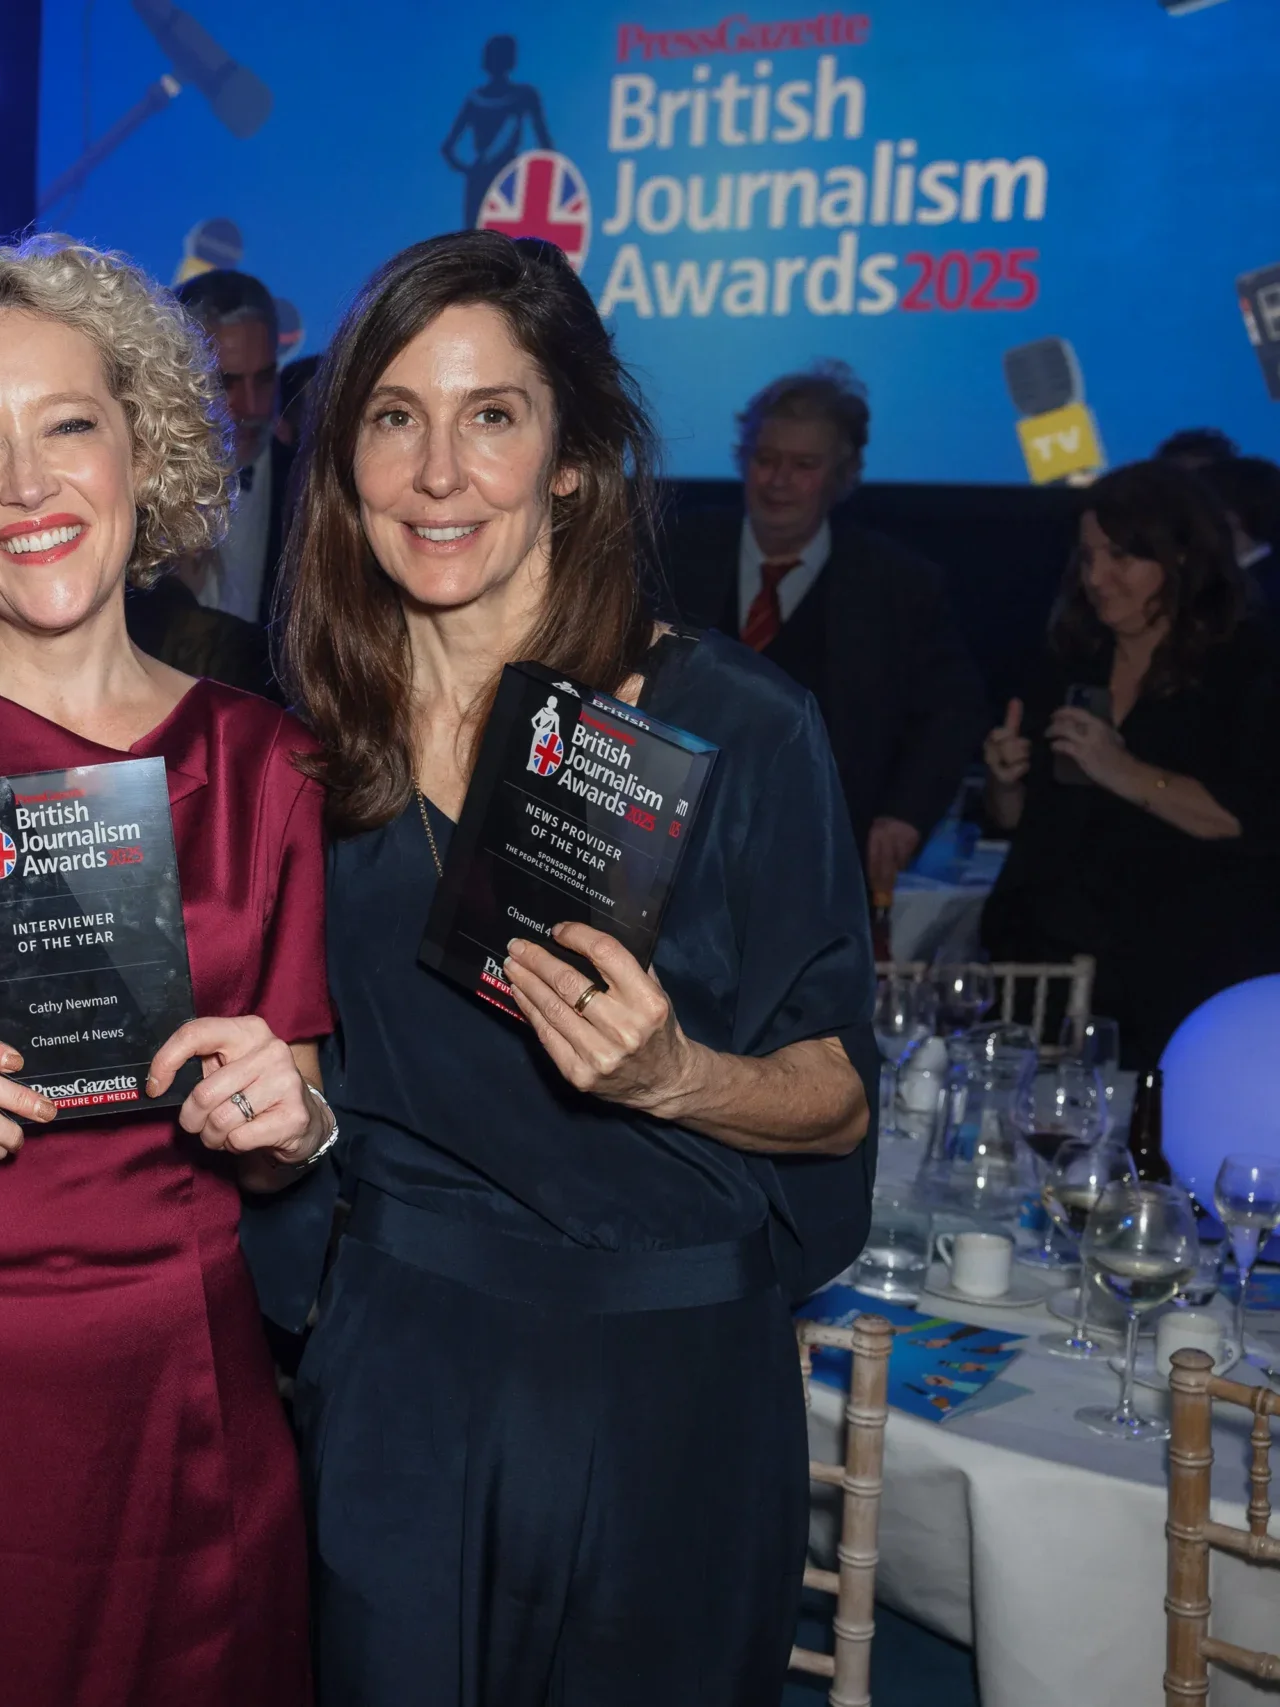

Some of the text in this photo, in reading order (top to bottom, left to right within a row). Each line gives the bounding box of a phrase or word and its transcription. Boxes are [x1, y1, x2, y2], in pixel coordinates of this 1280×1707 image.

[617, 13, 870, 63] PressGazette
[608, 55, 867, 152] British
[602, 139, 1048, 236] Journalism
[1032, 425, 1080, 463] TV
[571, 723, 632, 770] British
[564, 746, 664, 811] Journalism
[15, 800, 89, 830] British
[20, 821, 141, 853] Journalism
[525, 803, 622, 861] NEWS PROVIDER
[531, 824, 606, 872] OF THE YEAR
[505, 843, 616, 907] THE PEOPLE'S POSTCODE LOTTERY
[537, 851, 587, 882] SPONSORED BY
[12, 912, 115, 935] INTERVIEWER
[507, 906, 552, 938] Channel 4
[18, 930, 114, 953] OF THE YEAR
[481, 973, 514, 996] THE FUT
[29, 995, 118, 1014] Cathy Newman
[31, 1028, 124, 1048] Channel 4 News
[54, 1091, 138, 1107] FUTURE OF MEDIA
